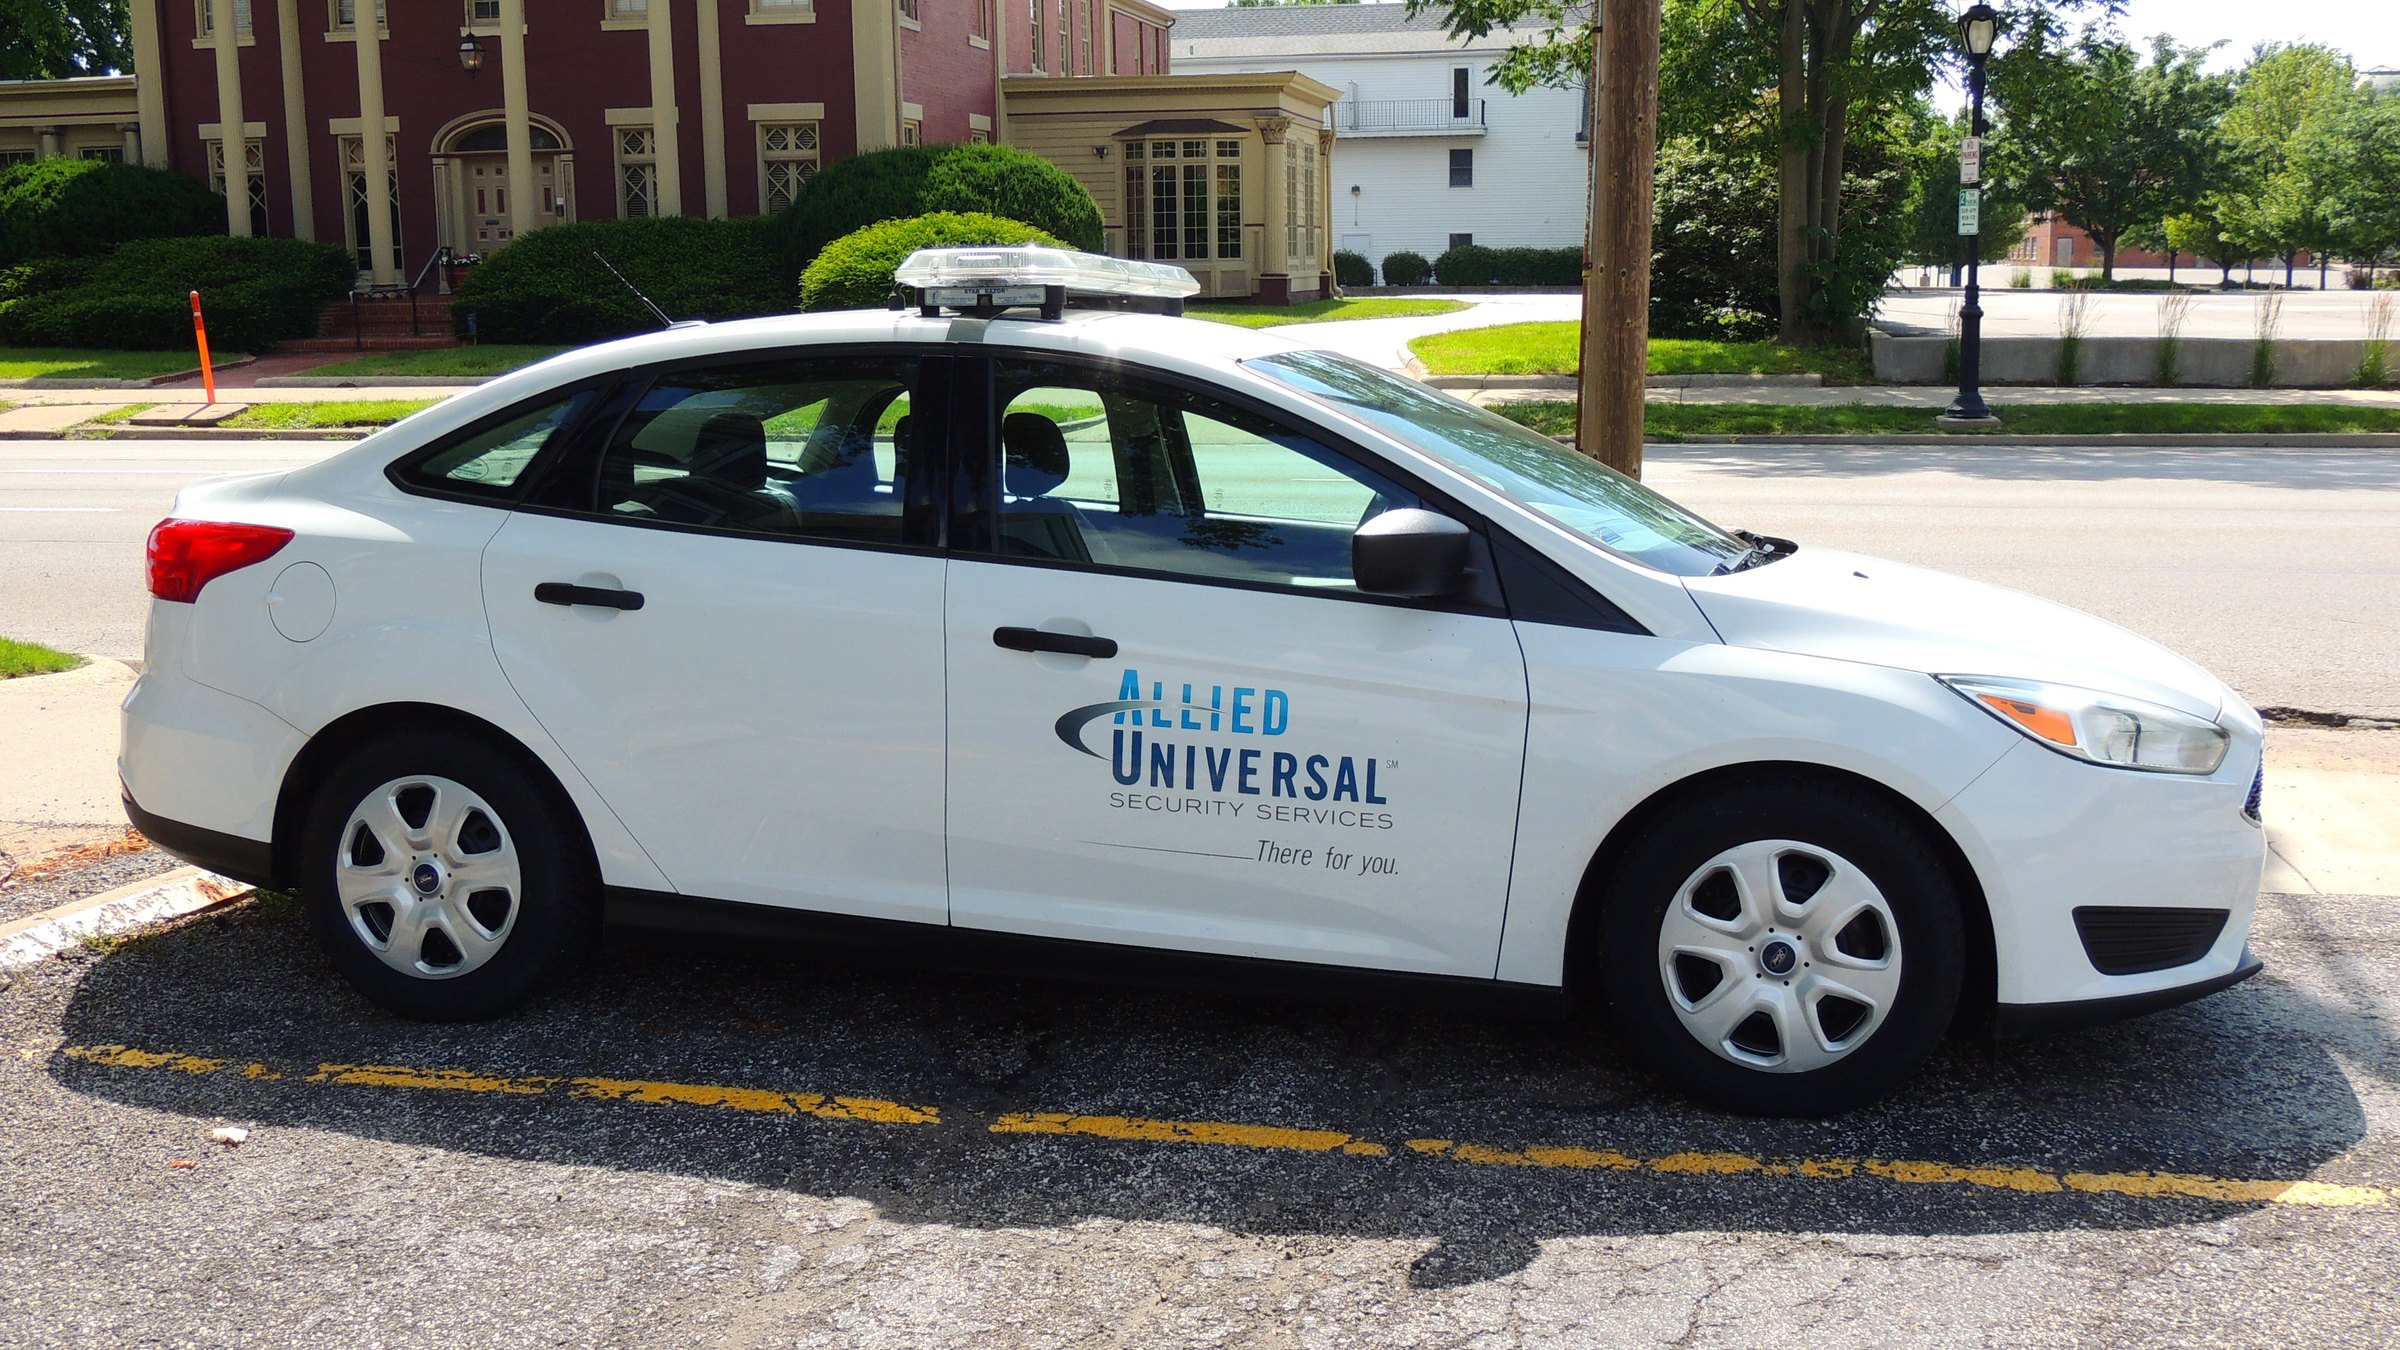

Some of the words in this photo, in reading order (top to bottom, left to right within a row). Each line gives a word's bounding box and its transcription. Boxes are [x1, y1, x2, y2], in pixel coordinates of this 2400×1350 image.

[1113, 669, 1289, 736] ALLIED
[1112, 729, 1387, 805] UNIVERSAL
[1386, 759, 1399, 770] SM
[1109, 792, 1244, 817] SECURITY
[1256, 804, 1394, 830] SERVICES
[1257, 840, 1313, 866] There
[1325, 846, 1354, 870] for
[1358, 854, 1400, 877] you.
